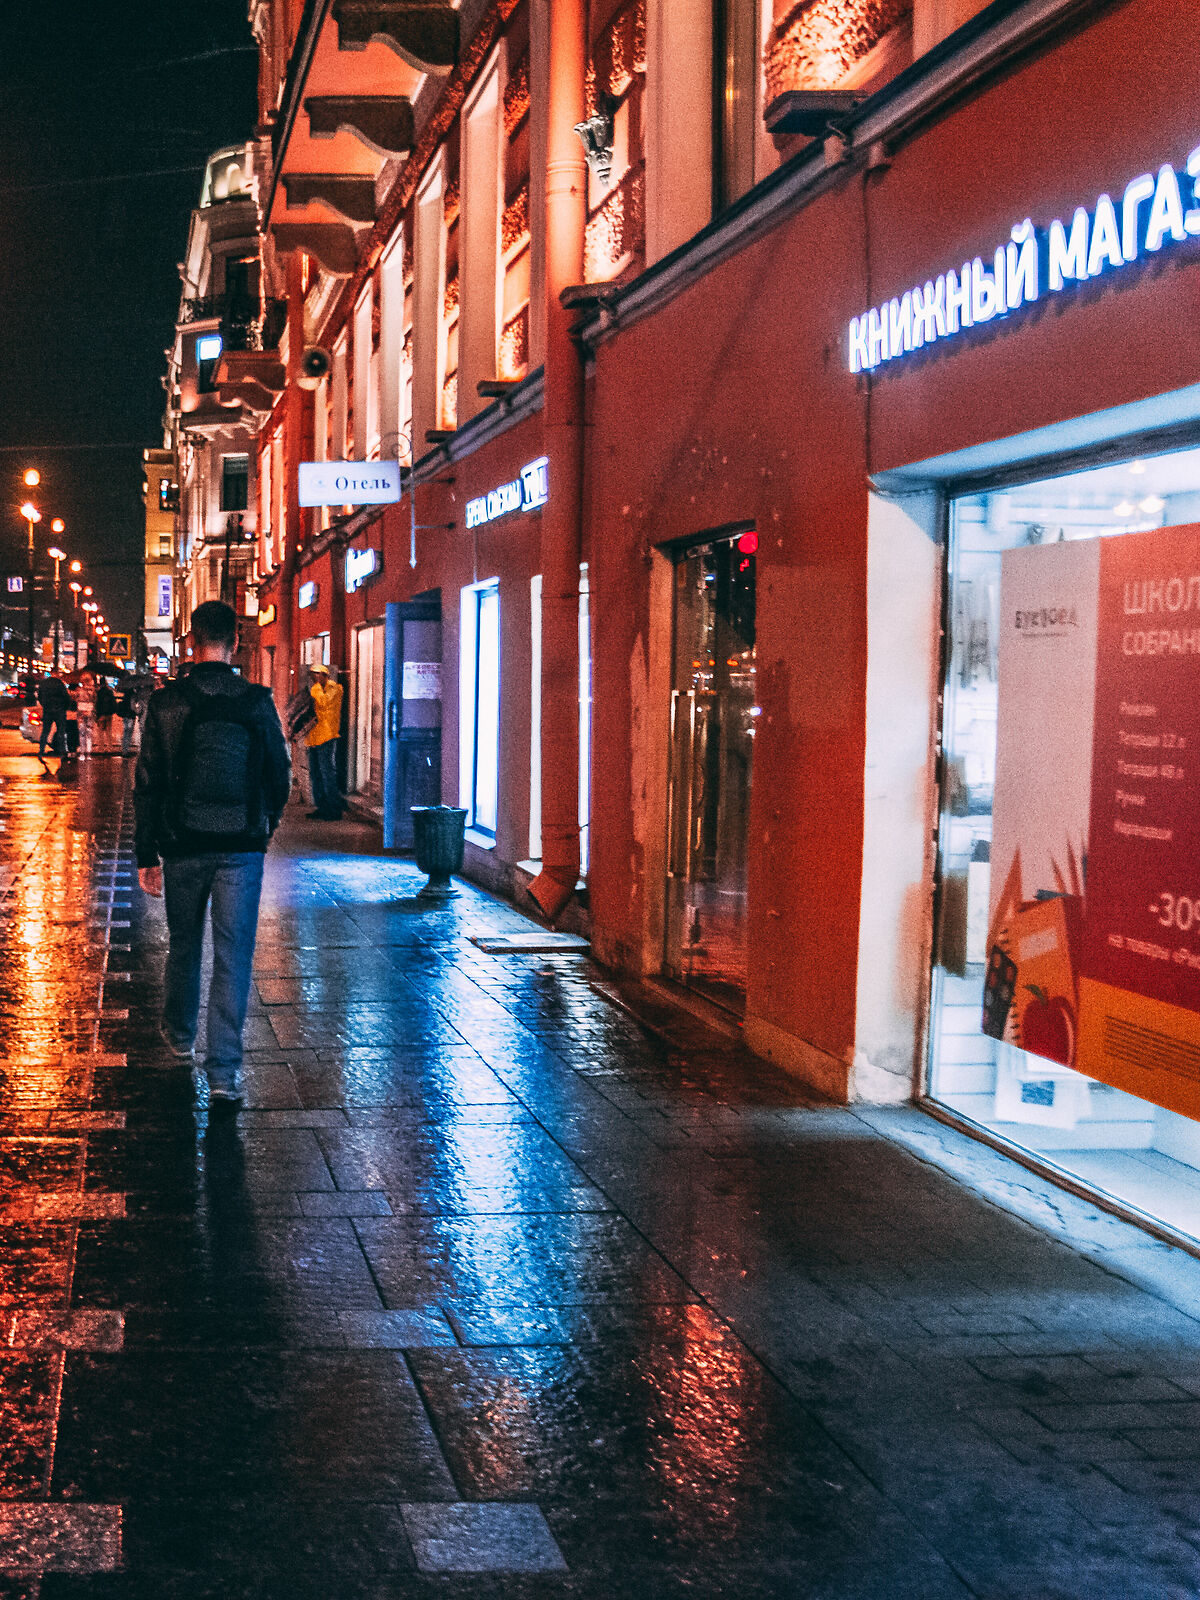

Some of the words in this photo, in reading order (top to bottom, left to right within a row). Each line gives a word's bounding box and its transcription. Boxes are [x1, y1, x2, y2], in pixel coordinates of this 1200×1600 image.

[849, 217, 1039, 374] КНИЖНЫЙ
[335, 476, 391, 490] Отель
[1122, 628, 1200, 656] СОБРАН
